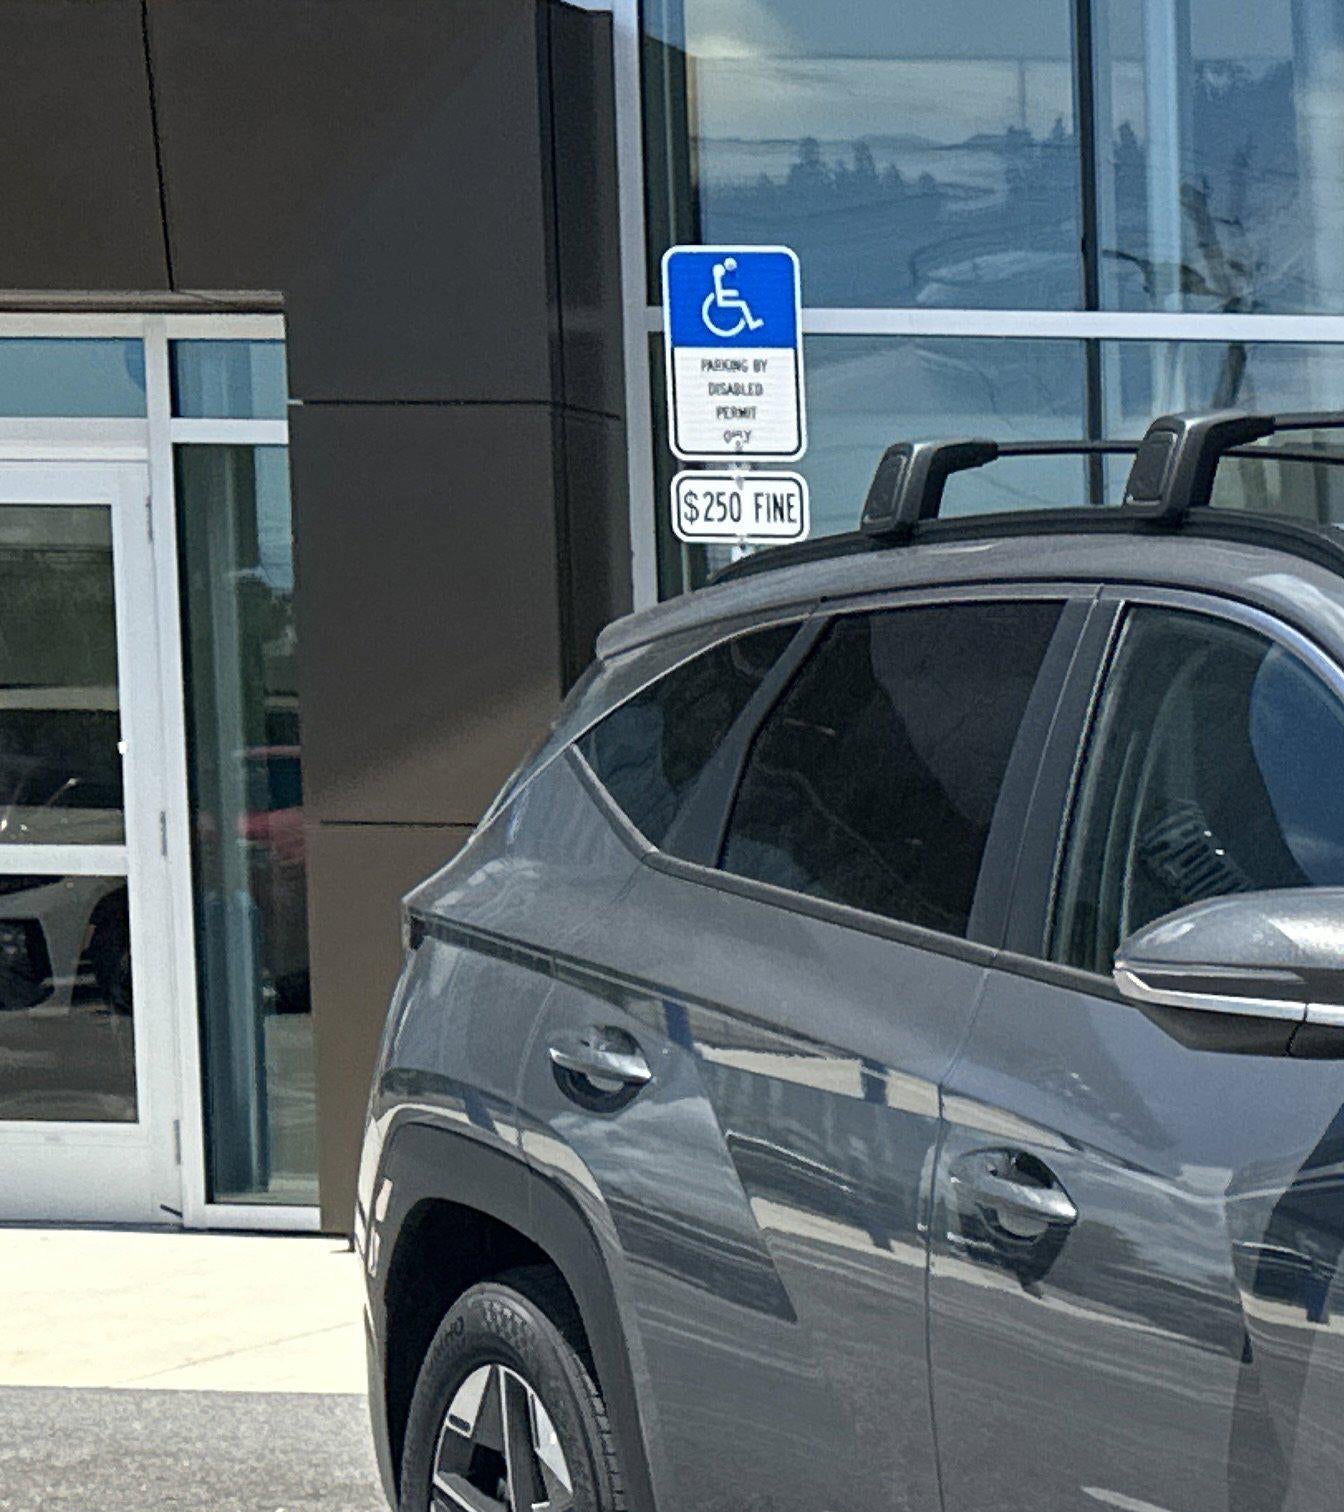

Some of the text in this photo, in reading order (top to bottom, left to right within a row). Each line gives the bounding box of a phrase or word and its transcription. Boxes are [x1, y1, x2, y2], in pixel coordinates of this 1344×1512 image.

[701, 358, 768, 373] PARKING BY
[708, 382, 763, 396] DISABLED
[716, 405, 757, 420] PERMIT
[683, 490, 797, 525] $250 FINE
